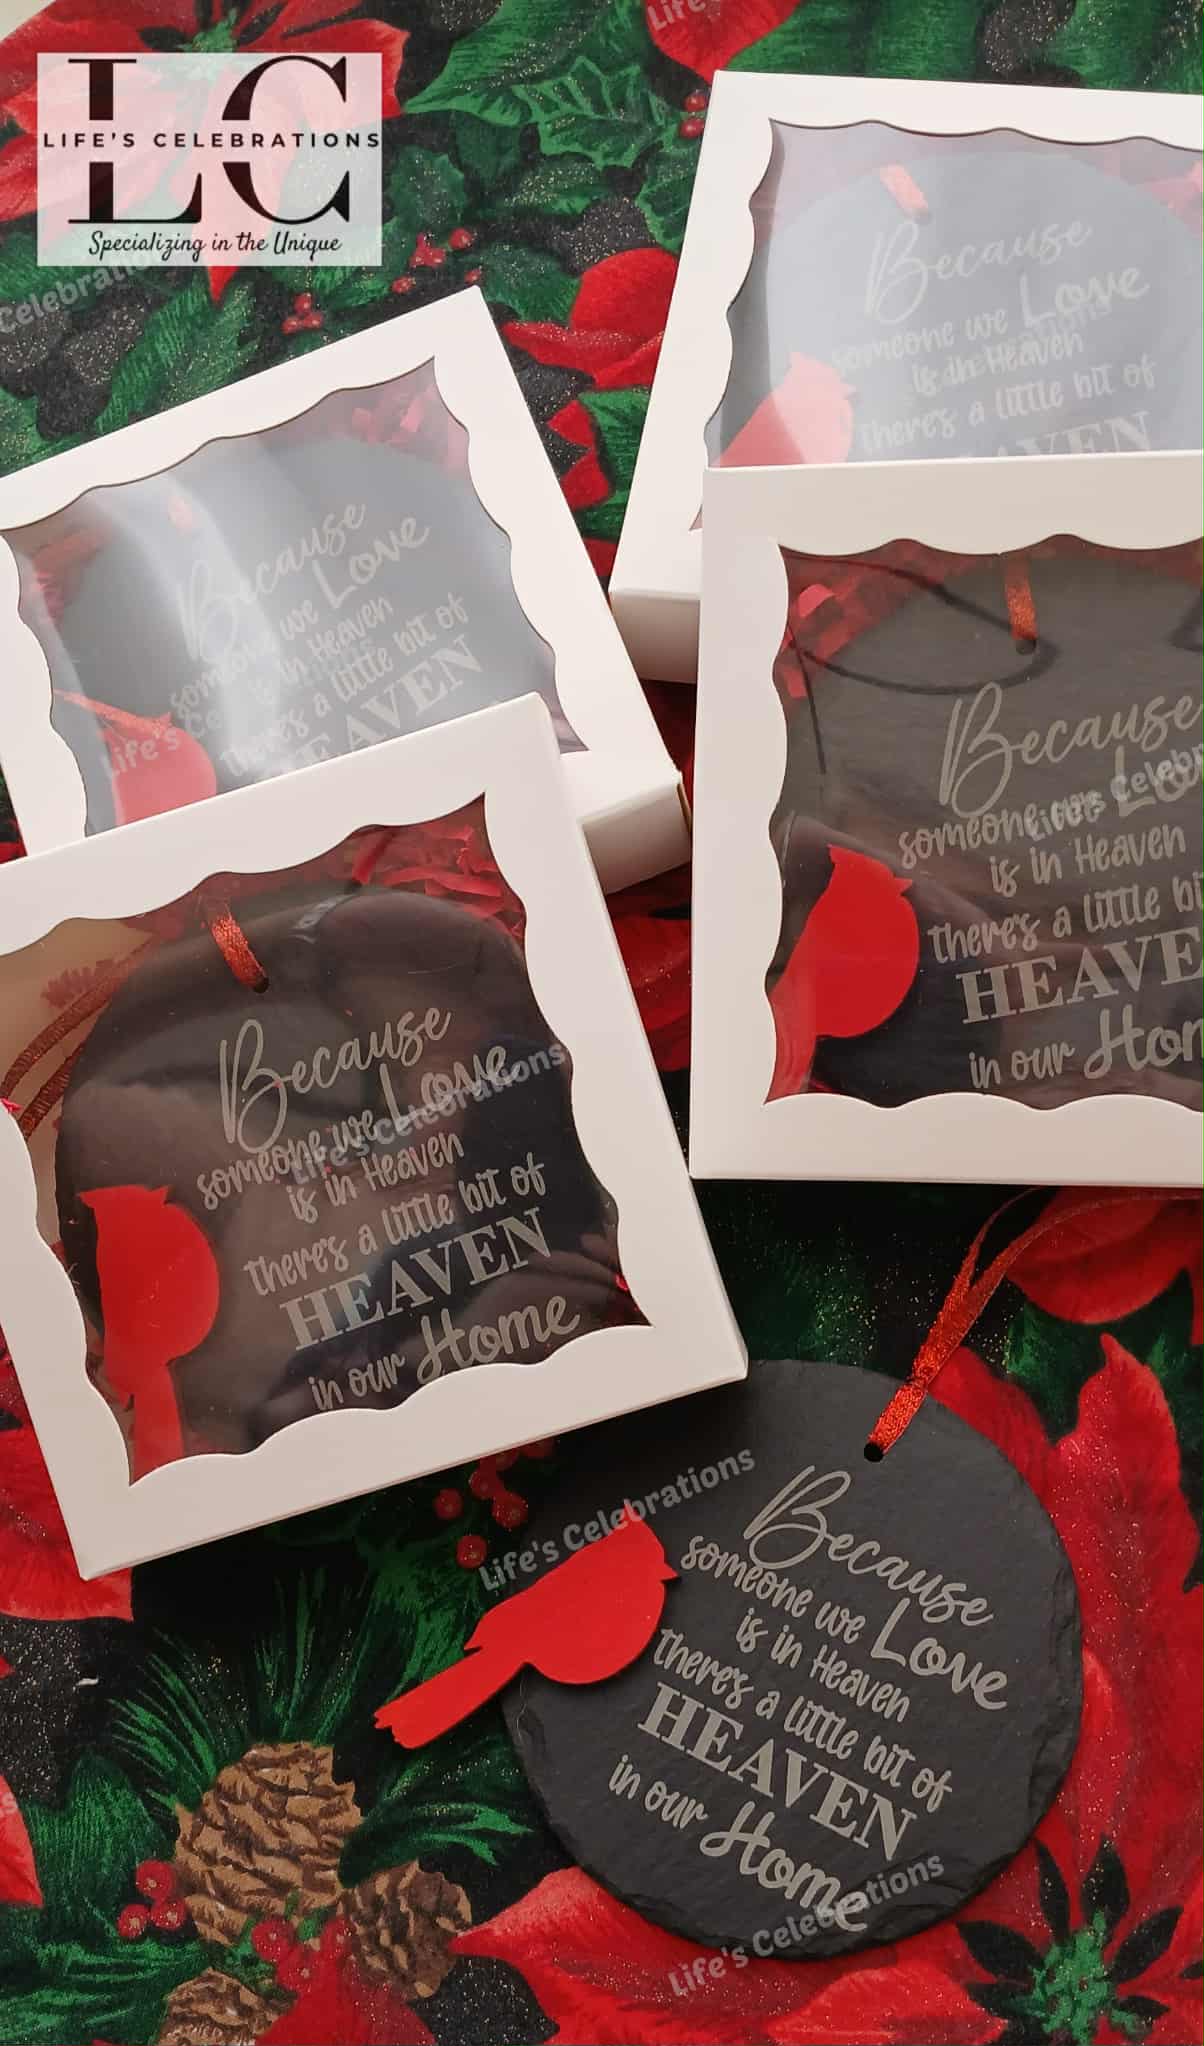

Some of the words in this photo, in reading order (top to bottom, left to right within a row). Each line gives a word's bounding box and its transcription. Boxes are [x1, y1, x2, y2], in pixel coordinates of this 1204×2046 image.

[831, 321, 954, 371] someone
[965, 308, 1009, 341] we
[1019, 267, 1150, 328] Love
[864, 219, 1093, 324] Because
[968, 400, 985, 427] a
[996, 379, 1065, 420] little
[1072, 363, 1118, 400] bit
[1123, 351, 1156, 391] of
[279, 598, 320, 642] we
[311, 516, 430, 609] Love
[279, 656, 306, 687] in
[307, 595, 394, 663] Heaven
[313, 693, 332, 719] a
[332, 646, 394, 704] little
[393, 612, 437, 656] bit
[435, 591, 469, 629] of
[938, 681, 1204, 819] Because
[899, 803, 1038, 869] someone
[989, 855, 1021, 898] is
[1029, 846, 1063, 886] in
[1072, 823, 1187, 875] Heaven
[927, 912, 1041, 964] there's
[1052, 905, 1072, 938] a
[1082, 883, 1161, 934] little
[196, 1130, 326, 1211] someone
[332, 1109, 378, 1152] we
[379, 1045, 523, 1130] Love
[219, 1007, 453, 1154] Because
[968, 1051, 1001, 1089] in
[1010, 1041, 1076, 1082] our
[243, 1234, 348, 1297] there's
[358, 1223, 377, 1255] a
[381, 1191, 455, 1247] little
[457, 1167, 508, 1214] bit
[510, 1151, 547, 1198] of
[286, 1184, 319, 1225] is
[324, 1171, 359, 1206] in
[360, 1131, 465, 1192] Heaven
[279, 1206, 552, 1351] HEAVEN
[307, 1375, 345, 1411] in
[348, 1351, 406, 1398] our
[416, 1294, 581, 1385] Home
[742, 1465, 994, 1627] Because
[680, 1535, 815, 1618] someone
[814, 1600, 867, 1645] we
[870, 1597, 1009, 1711] Love
[735, 1608, 769, 1654] is
[770, 1624, 803, 1670] in
[809, 1643, 911, 1723] Heaven
[637, 1680, 918, 1862] HEAVEN
[652, 1627, 755, 1711] there's
[755, 1689, 781, 1720] a
[782, 1695, 860, 1761] little
[863, 1735, 916, 1788] bit
[911, 1767, 954, 1814] of
[607, 1754, 642, 1800] in
[644, 1779, 710, 1830] our
[699, 1800, 868, 1933] Home
